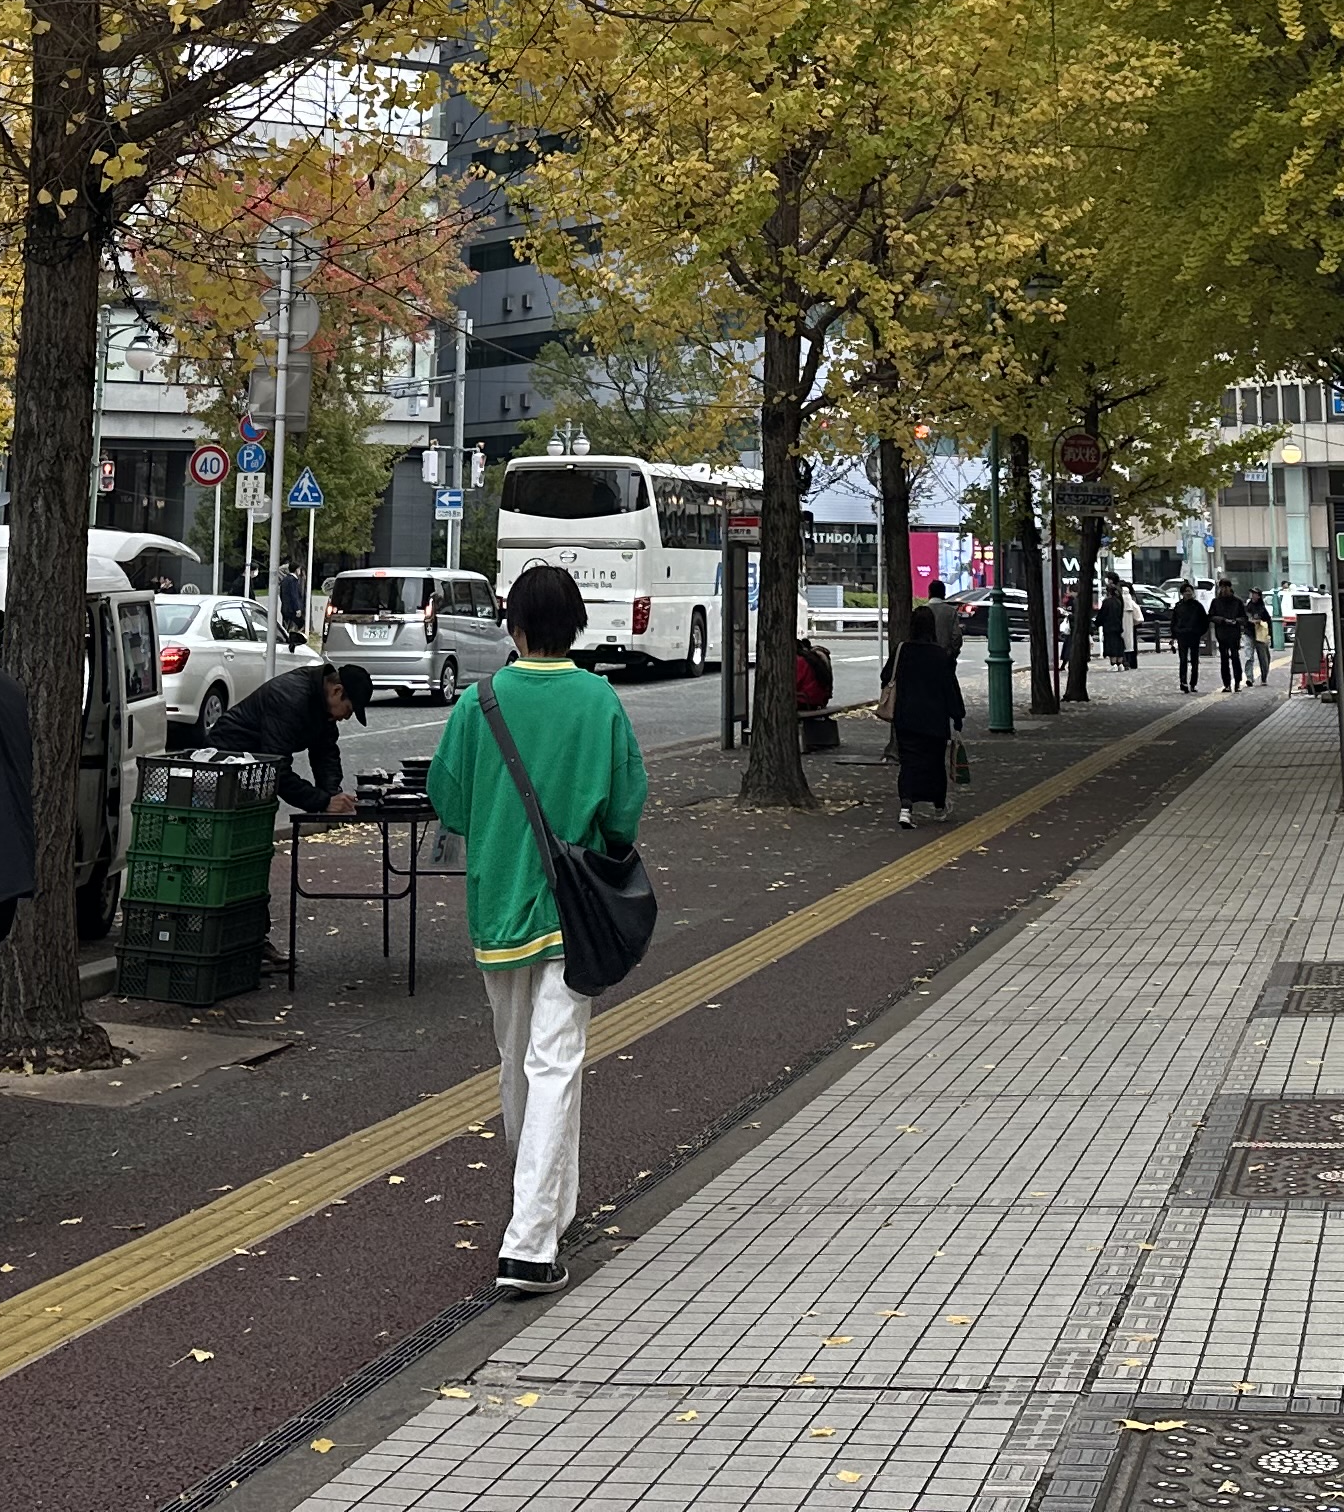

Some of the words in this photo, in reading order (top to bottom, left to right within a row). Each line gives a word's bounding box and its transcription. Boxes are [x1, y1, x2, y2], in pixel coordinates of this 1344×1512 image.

[199, 457, 220, 474] 40
[243, 450, 255, 469] P
[572, 567, 616, 580] arine
